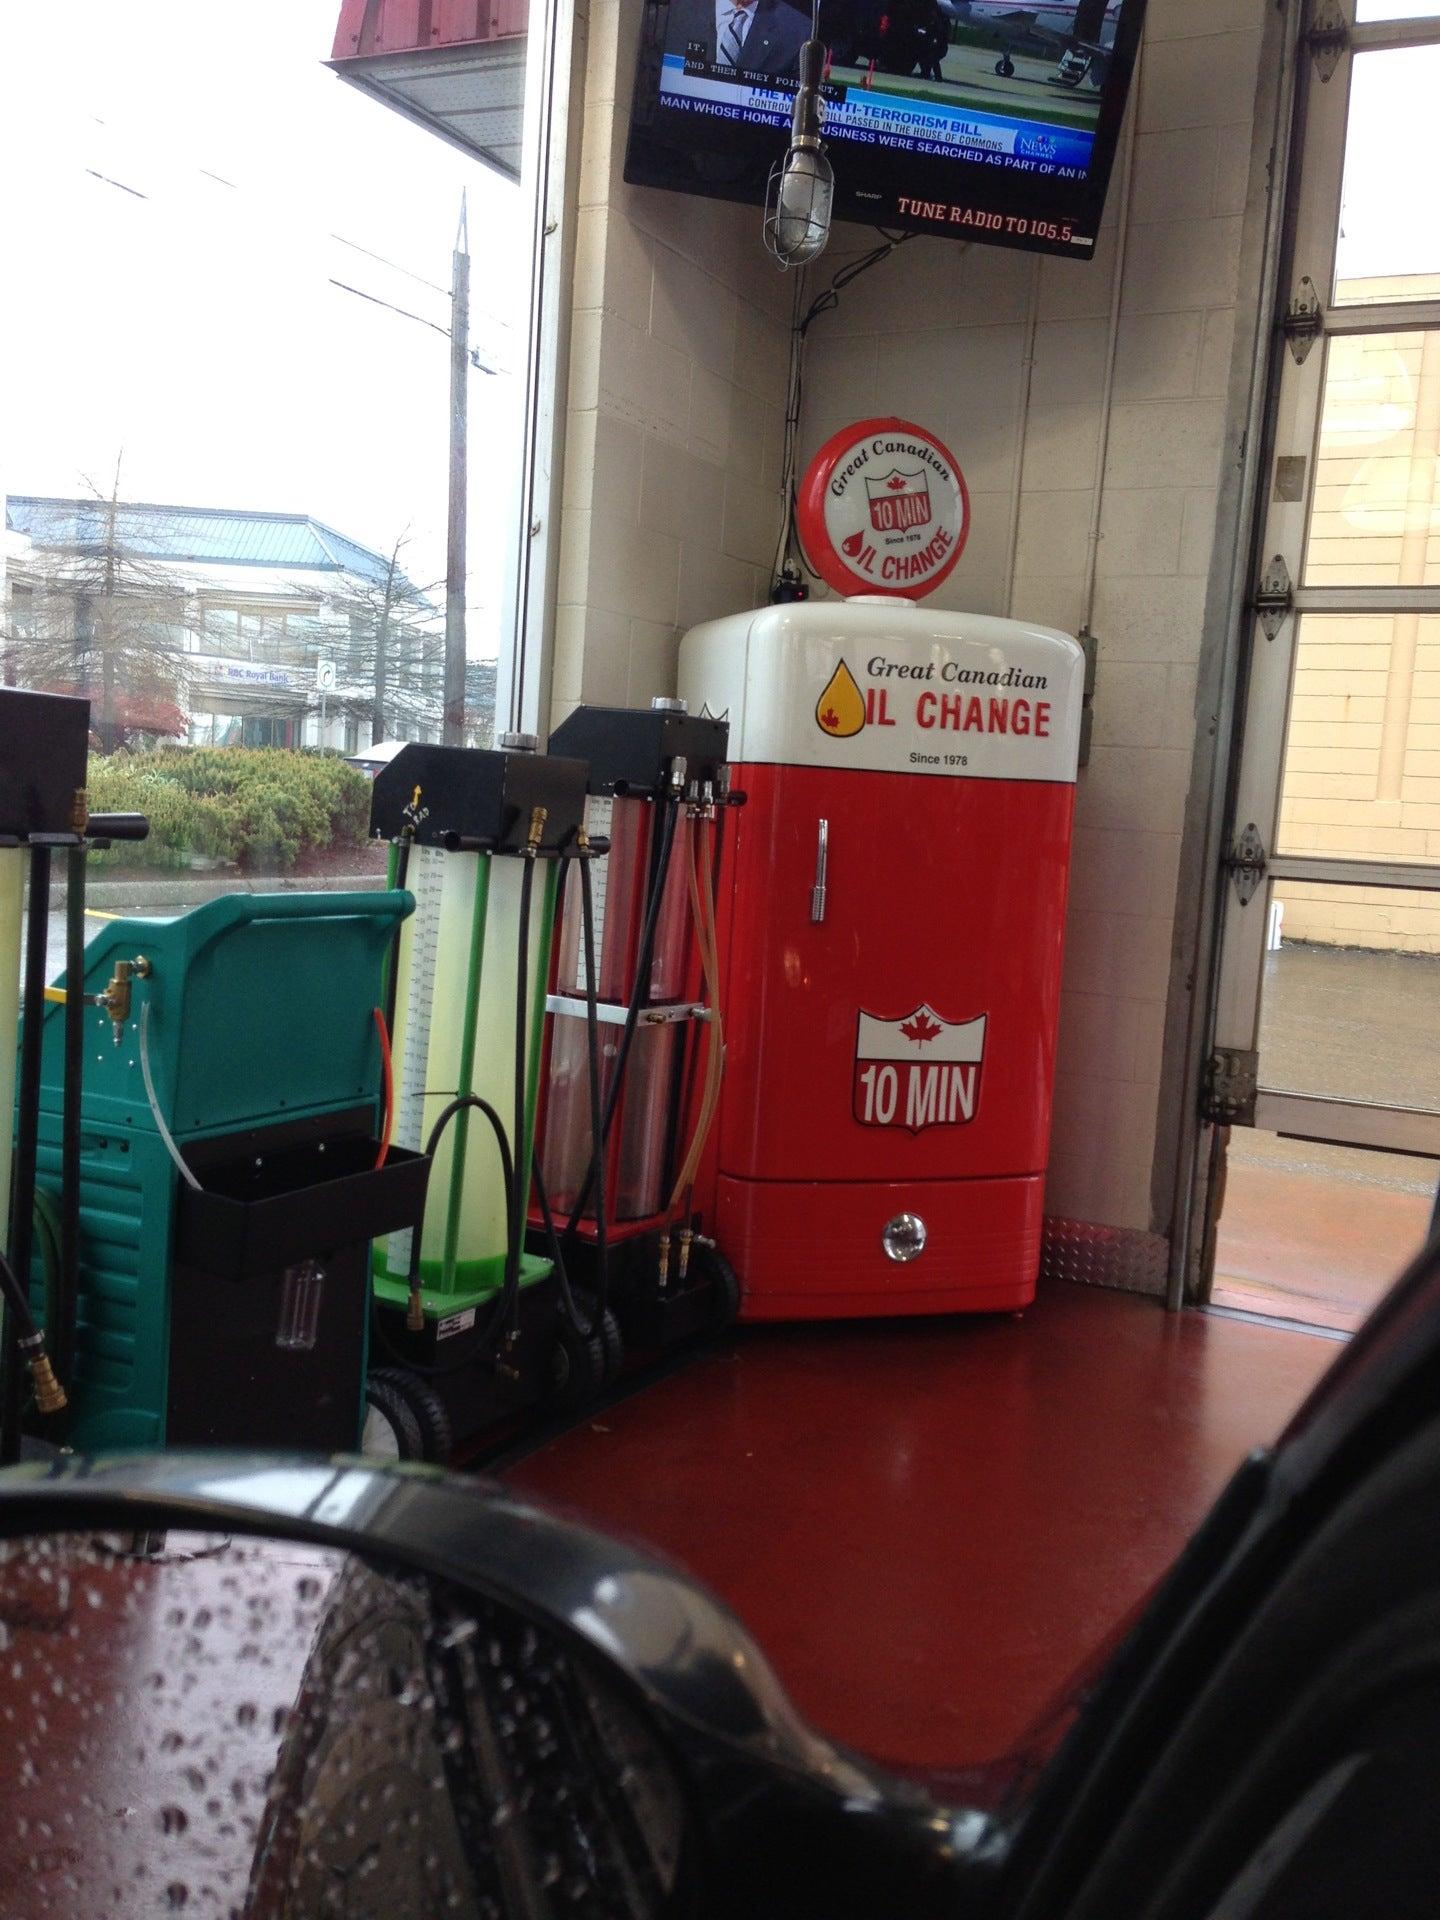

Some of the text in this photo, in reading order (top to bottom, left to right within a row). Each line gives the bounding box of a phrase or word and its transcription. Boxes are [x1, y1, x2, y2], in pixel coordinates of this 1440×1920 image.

[685, 61, 838, 96] AND THEN THEY POIN UT,
[660, 96, 690, 110] MAN
[693, 101, 740, 119] WHOSE
[743, 110, 780, 126] HOME
[821, 125, 875, 143] USINESS
[878, 134, 914, 150] WERE
[917, 141, 983, 162] SEARCHED
[985, 154, 1002, 166] AS
[1004, 156, 1037, 171] PART
[1039, 163, 1056, 174] OF
[1057, 166, 1076, 178] AN
[846, 115, 880, 129] PASSED
[883, 122, 892, 131] IN
[895, 123, 911, 134] THE
[913, 128, 942, 140] HOUSE
[945, 132, 957, 142] OF
[960, 134, 1003, 151] COMMONS
[950, 121, 982, 136] BILL
[1020, 138, 1057, 155] NEWS
[1020, 149, 1054, 160] CHANNEL
[855, 190, 882, 200] SHARP
[898, 198, 1072, 241] TUNE RADIO TO 105.5
[831, 440, 950, 497] Great Canadian
[874, 496, 929, 529] 10 MIN
[881, 526, 953, 580] CHANGE
[867, 656, 1048, 690] Great Canadian
[916, 691, 1052, 738] CHANGE
[909, 752, 968, 767] Since 1978
[861, 1065, 976, 1127] 10 MIN
